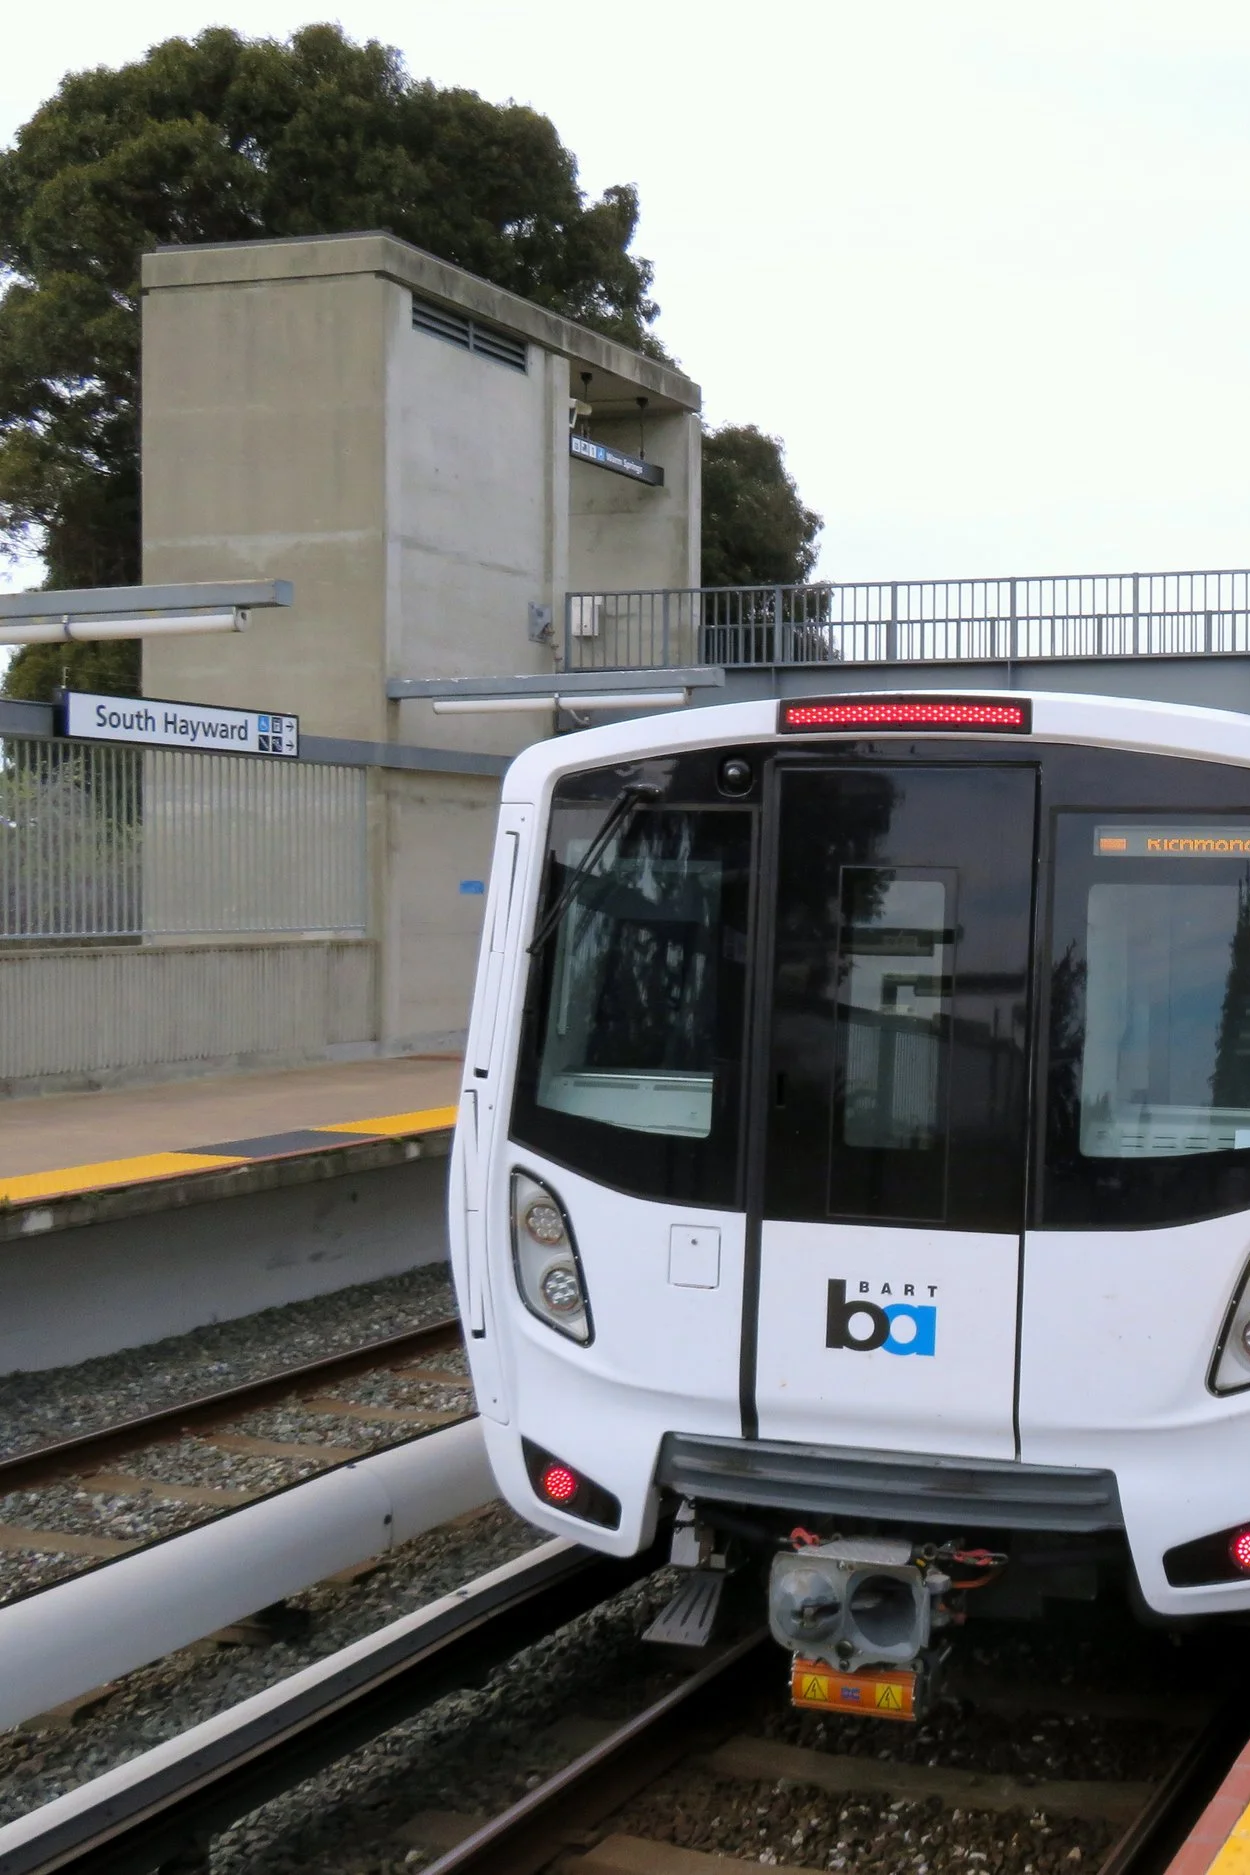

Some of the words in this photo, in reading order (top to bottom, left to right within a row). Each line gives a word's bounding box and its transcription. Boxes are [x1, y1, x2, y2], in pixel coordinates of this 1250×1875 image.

[95, 704, 156, 732] South
[163, 712, 249, 741] Hayward
[859, 1281, 938, 1298] BART
